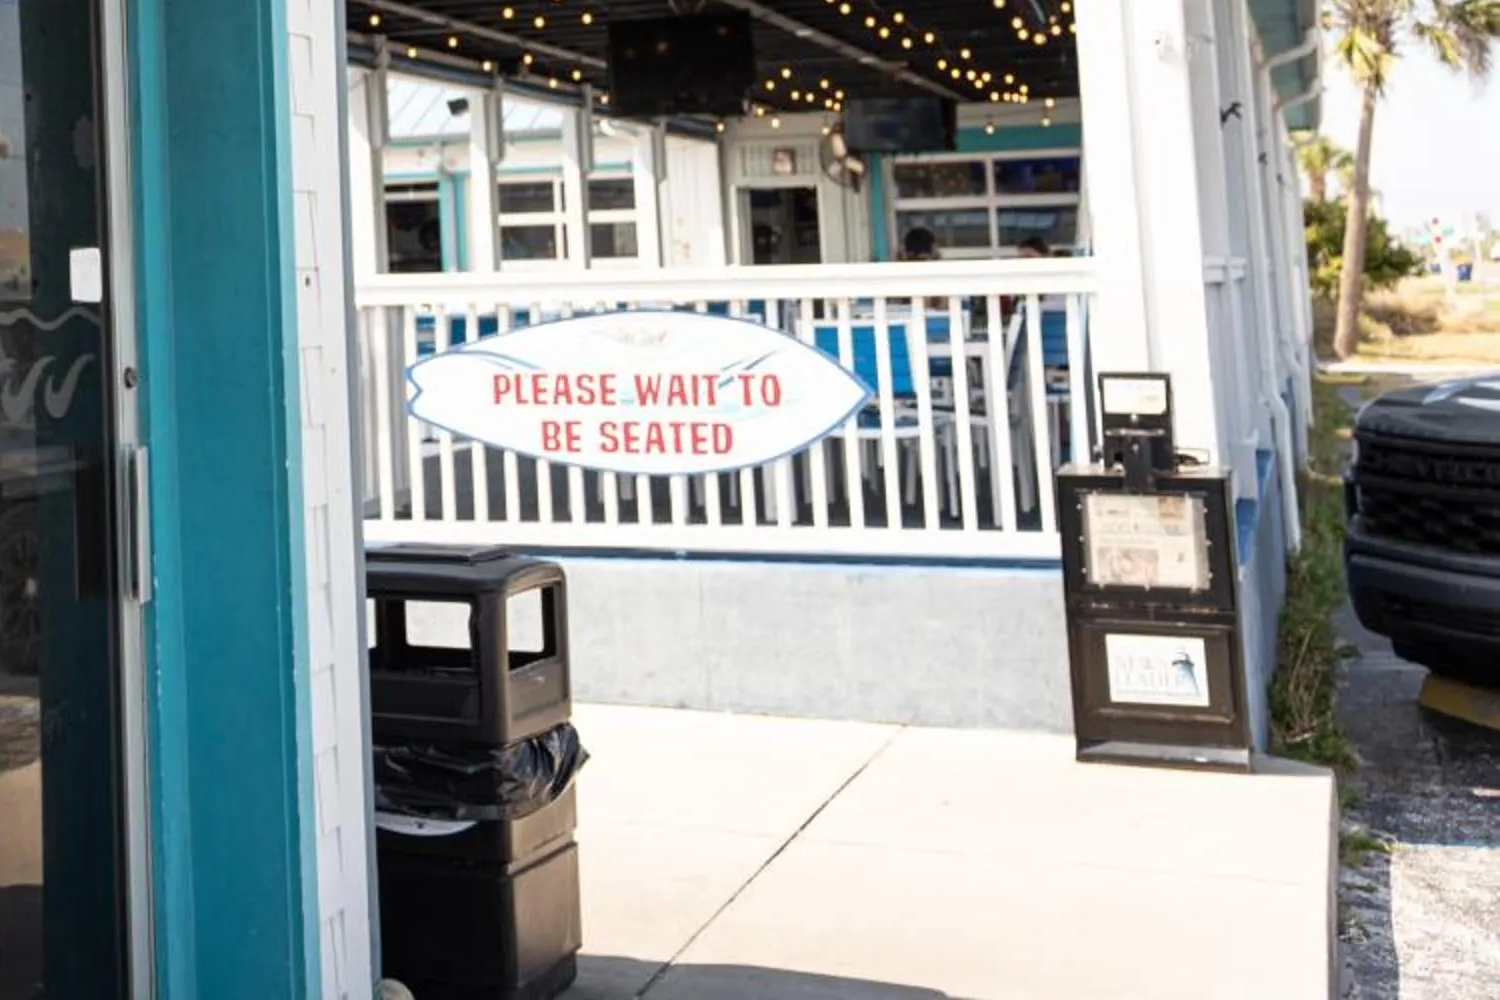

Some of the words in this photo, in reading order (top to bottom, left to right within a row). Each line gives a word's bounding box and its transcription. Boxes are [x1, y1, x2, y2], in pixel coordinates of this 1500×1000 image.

[492, 374, 616, 406] PLEASE
[634, 374, 720, 406] WAIT
[739, 374, 782, 407] TO
[541, 420, 582, 454] BE
[599, 421, 734, 456] SEATED
